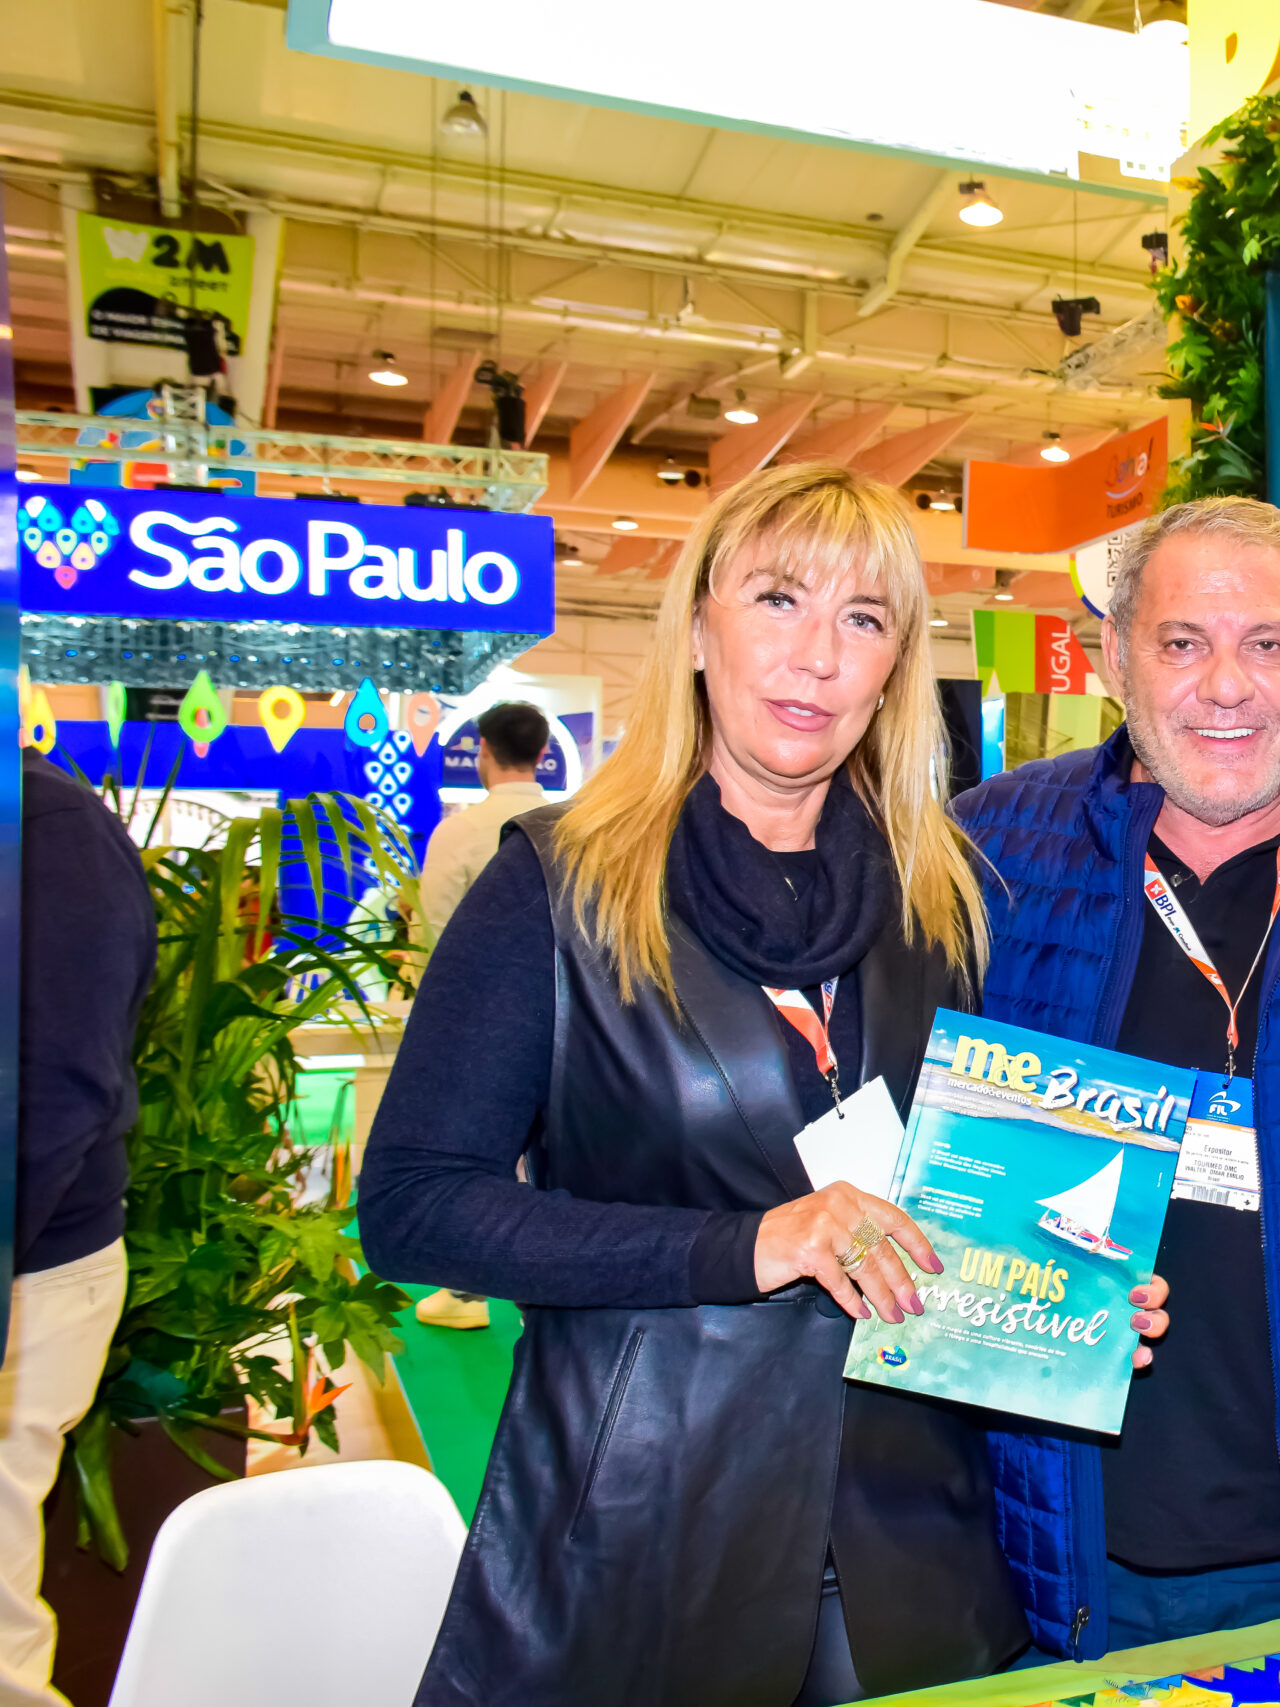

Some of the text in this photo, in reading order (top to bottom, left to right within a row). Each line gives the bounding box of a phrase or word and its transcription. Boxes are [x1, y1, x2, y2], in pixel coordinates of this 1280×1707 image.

[1106, 492, 1143, 518] TURISMO
[128, 510, 520, 605] São Paulo
[1155, 894, 1177, 917] BPI
[1039, 1067, 1177, 1133] Brasil
[1208, 1104, 1228, 1116] FIL
[1203, 1144, 1233, 1156] Expositor
[959, 1247, 1068, 1303] UM PAÍS
[910, 1272, 1109, 1346] rresistível
[884, 1353, 904, 1365] BRASIL
